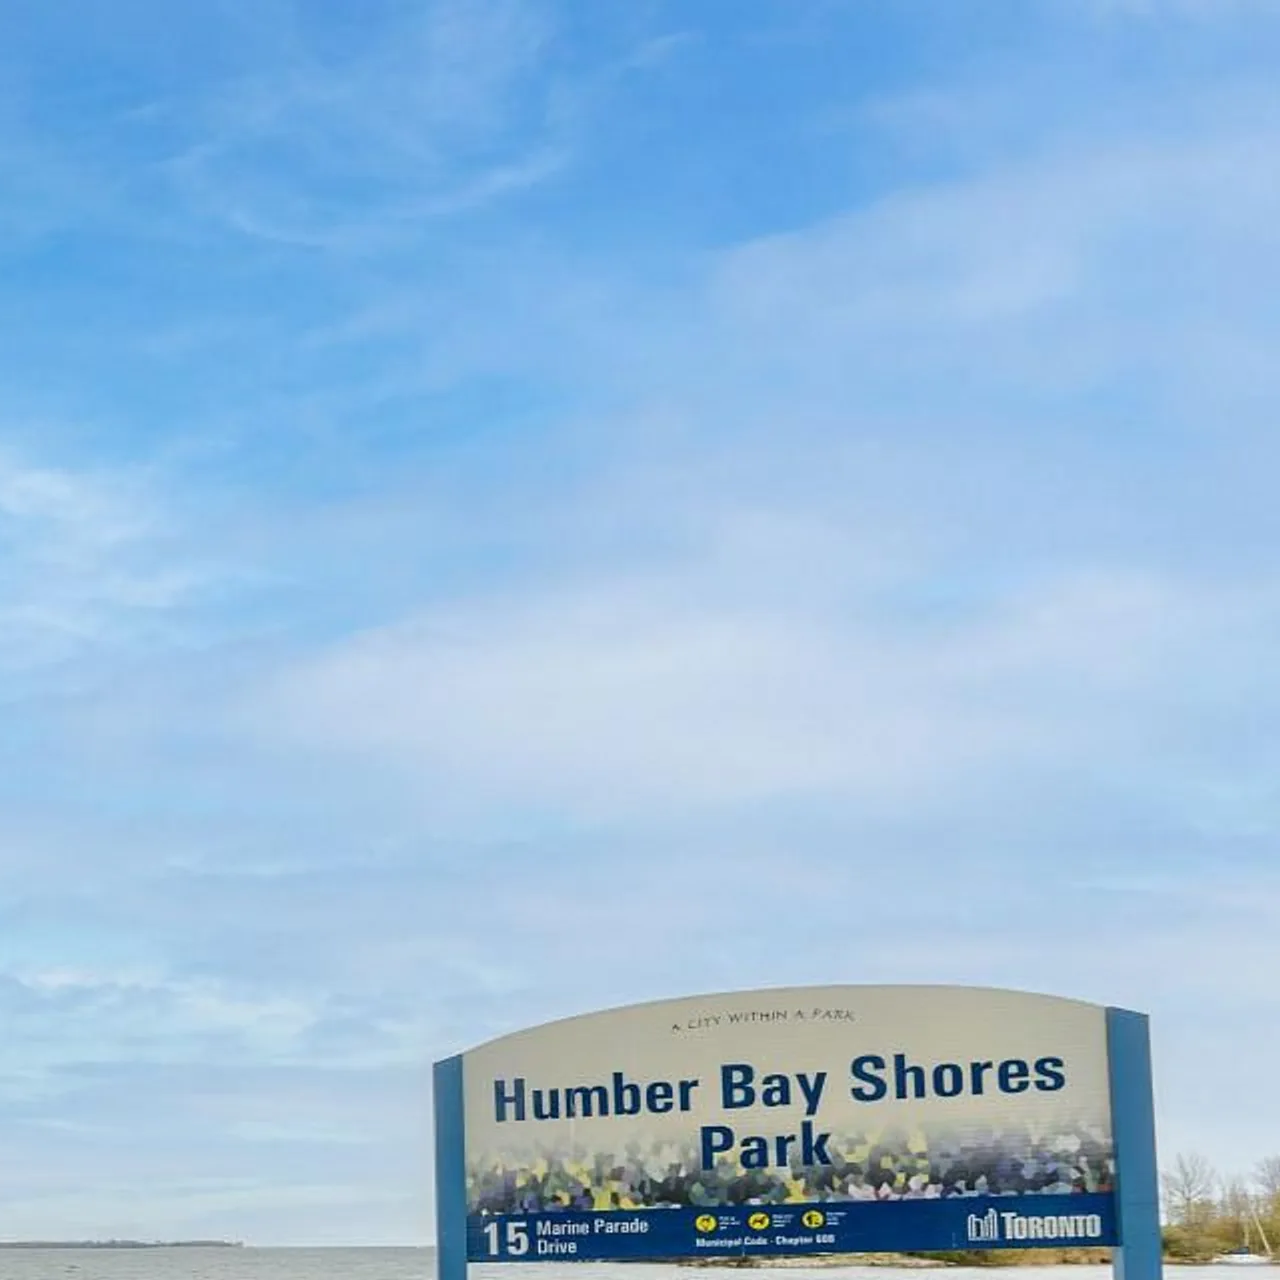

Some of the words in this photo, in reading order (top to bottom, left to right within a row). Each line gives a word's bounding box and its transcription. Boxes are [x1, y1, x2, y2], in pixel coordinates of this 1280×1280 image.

[688, 1015, 721, 1029] CITY
[728, 1009, 788, 1024] WITHIN
[795, 1009, 805, 1020] A
[812, 1007, 856, 1022] PARK
[494, 1071, 699, 1122] Humber
[721, 1063, 827, 1117] Bay
[851, 1053, 1066, 1102] Shores
[701, 1120, 832, 1171] Park
[483, 1221, 530, 1256] 15
[536, 1219, 590, 1236] Marine
[594, 1217, 649, 1234] Parade
[1000, 1211, 1102, 1240] TORONTO
[537, 1239, 577, 1254] Drive
